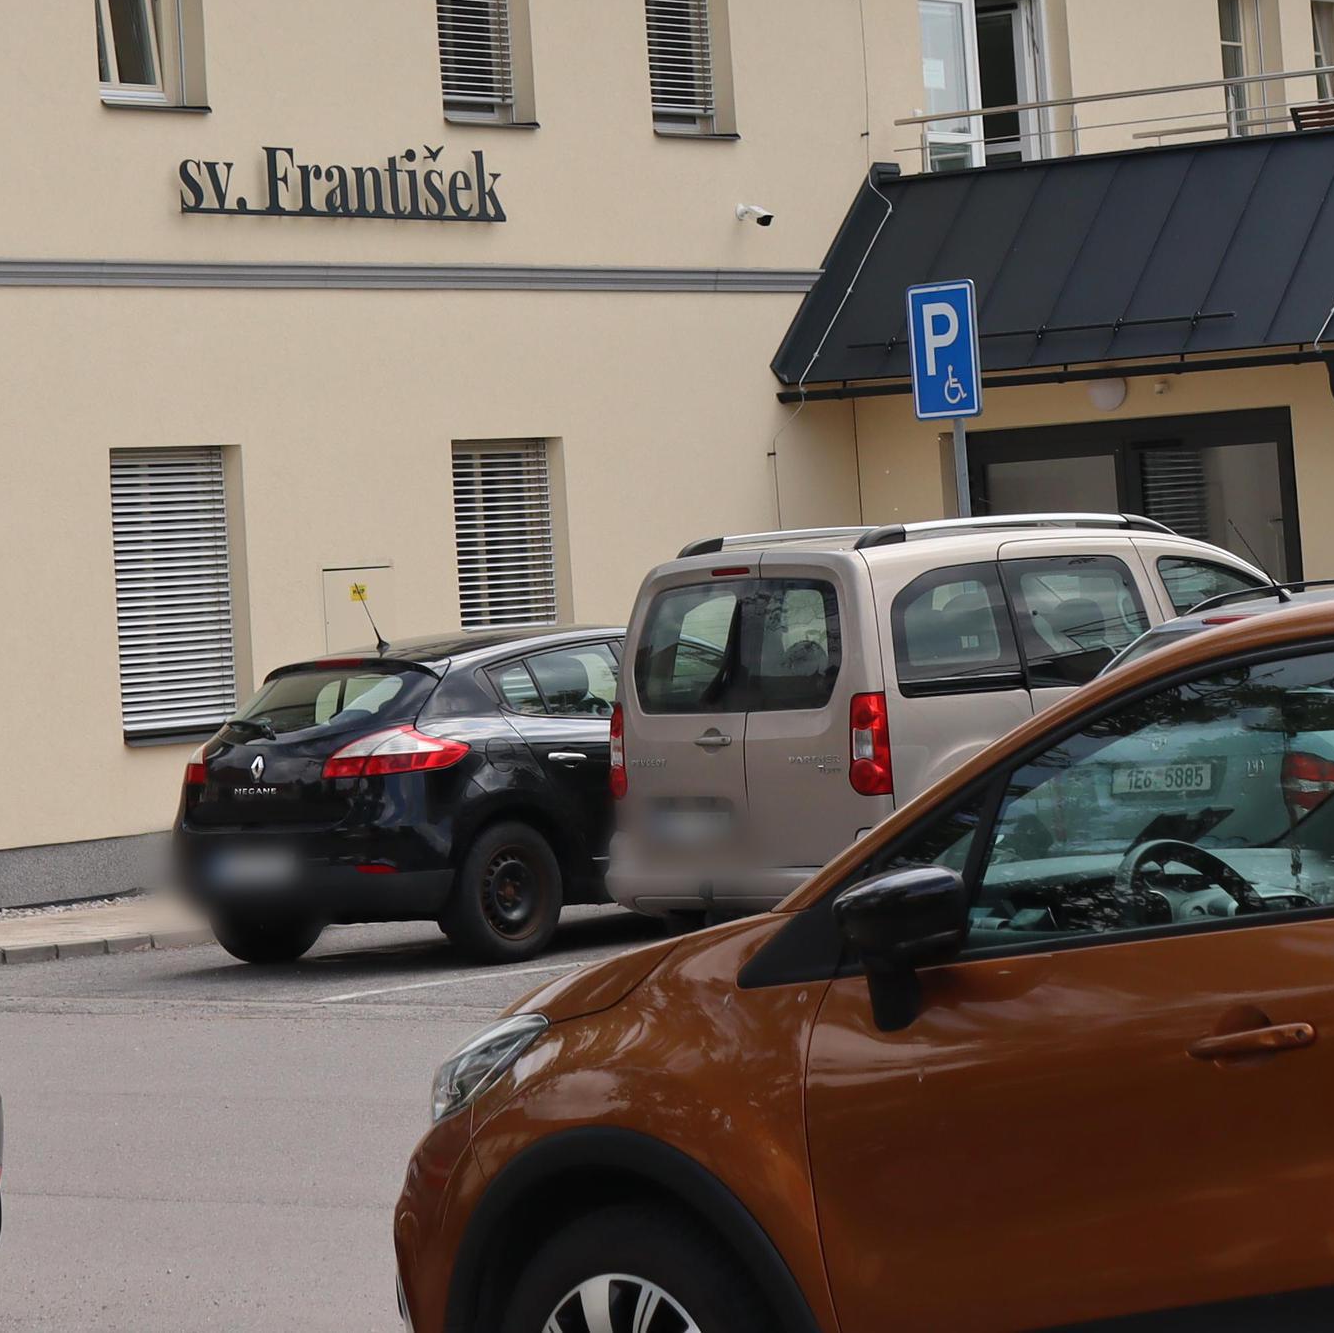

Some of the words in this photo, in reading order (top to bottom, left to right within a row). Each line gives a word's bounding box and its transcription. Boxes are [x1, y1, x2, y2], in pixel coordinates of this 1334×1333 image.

[178, 158, 247, 213] sv.
[261, 144, 507, 222] František
[922, 302, 959, 376] P
[1165, 767, 1203, 788] 5885
